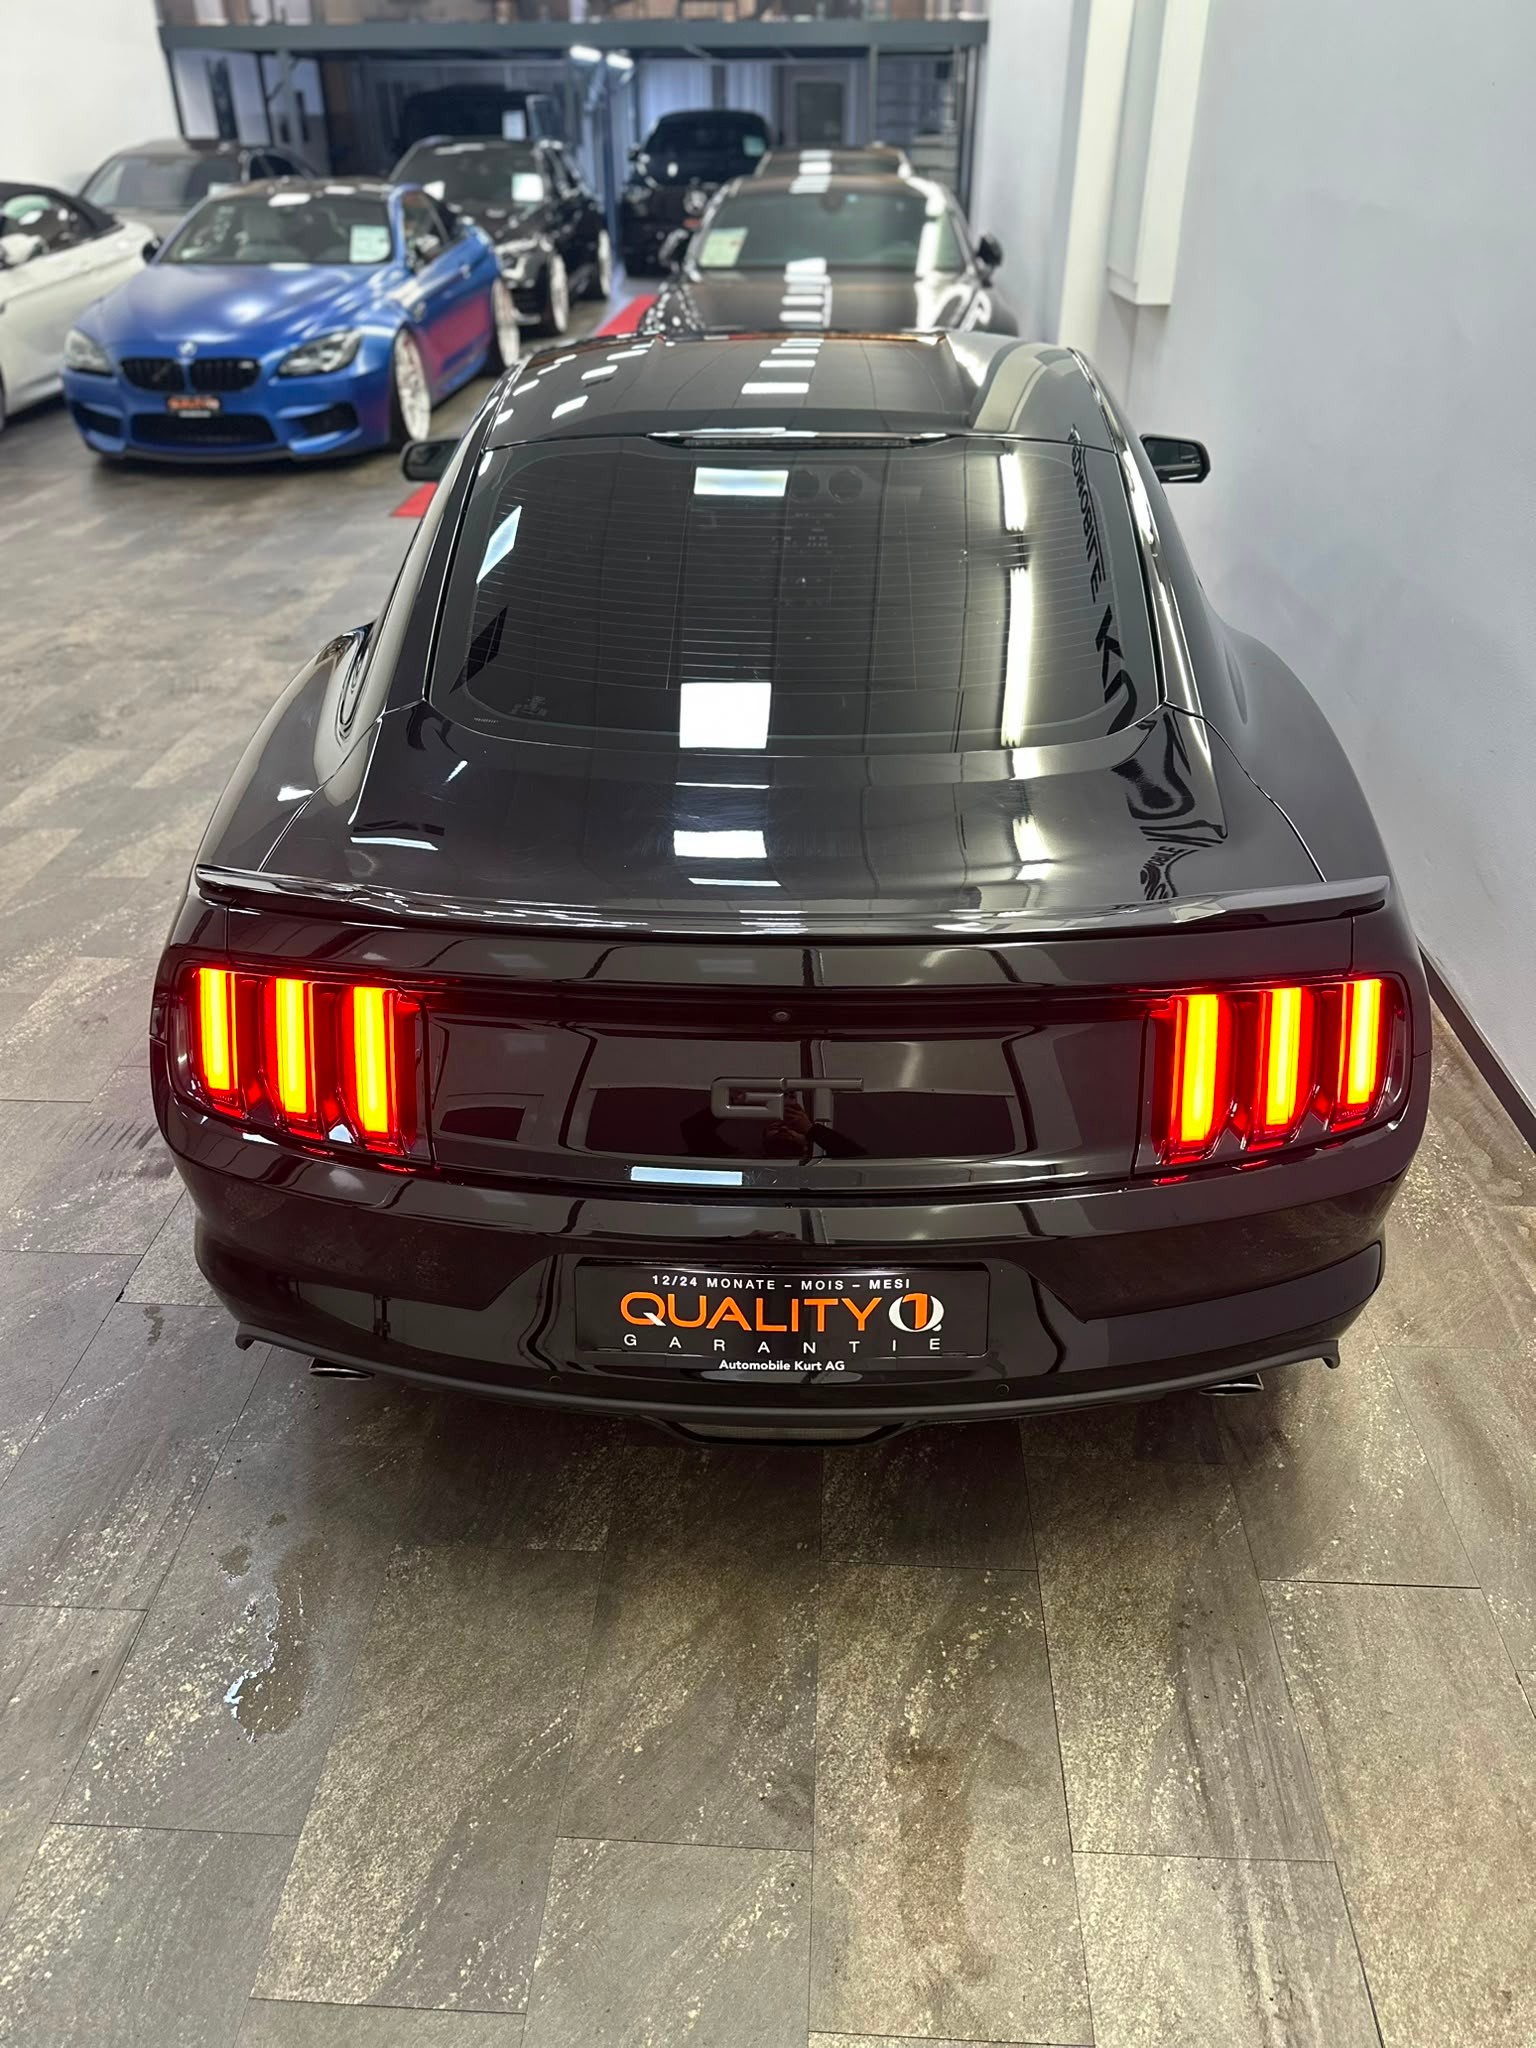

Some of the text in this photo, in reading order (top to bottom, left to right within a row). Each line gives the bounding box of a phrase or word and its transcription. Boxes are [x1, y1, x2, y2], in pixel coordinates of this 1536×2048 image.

[711, 1076, 864, 1123] GT
[652, 1274, 698, 1287] 12/24
[706, 1277, 776, 1290] MONATE
[801, 1279, 844, 1291] MOIS
[869, 1278, 910, 1290] MESI
[620, 1291, 883, 1332] QUALITY
[623, 1333, 941, 1355] GARANTIE
[719, 1358, 845, 1371] Automobile Kurt AG
